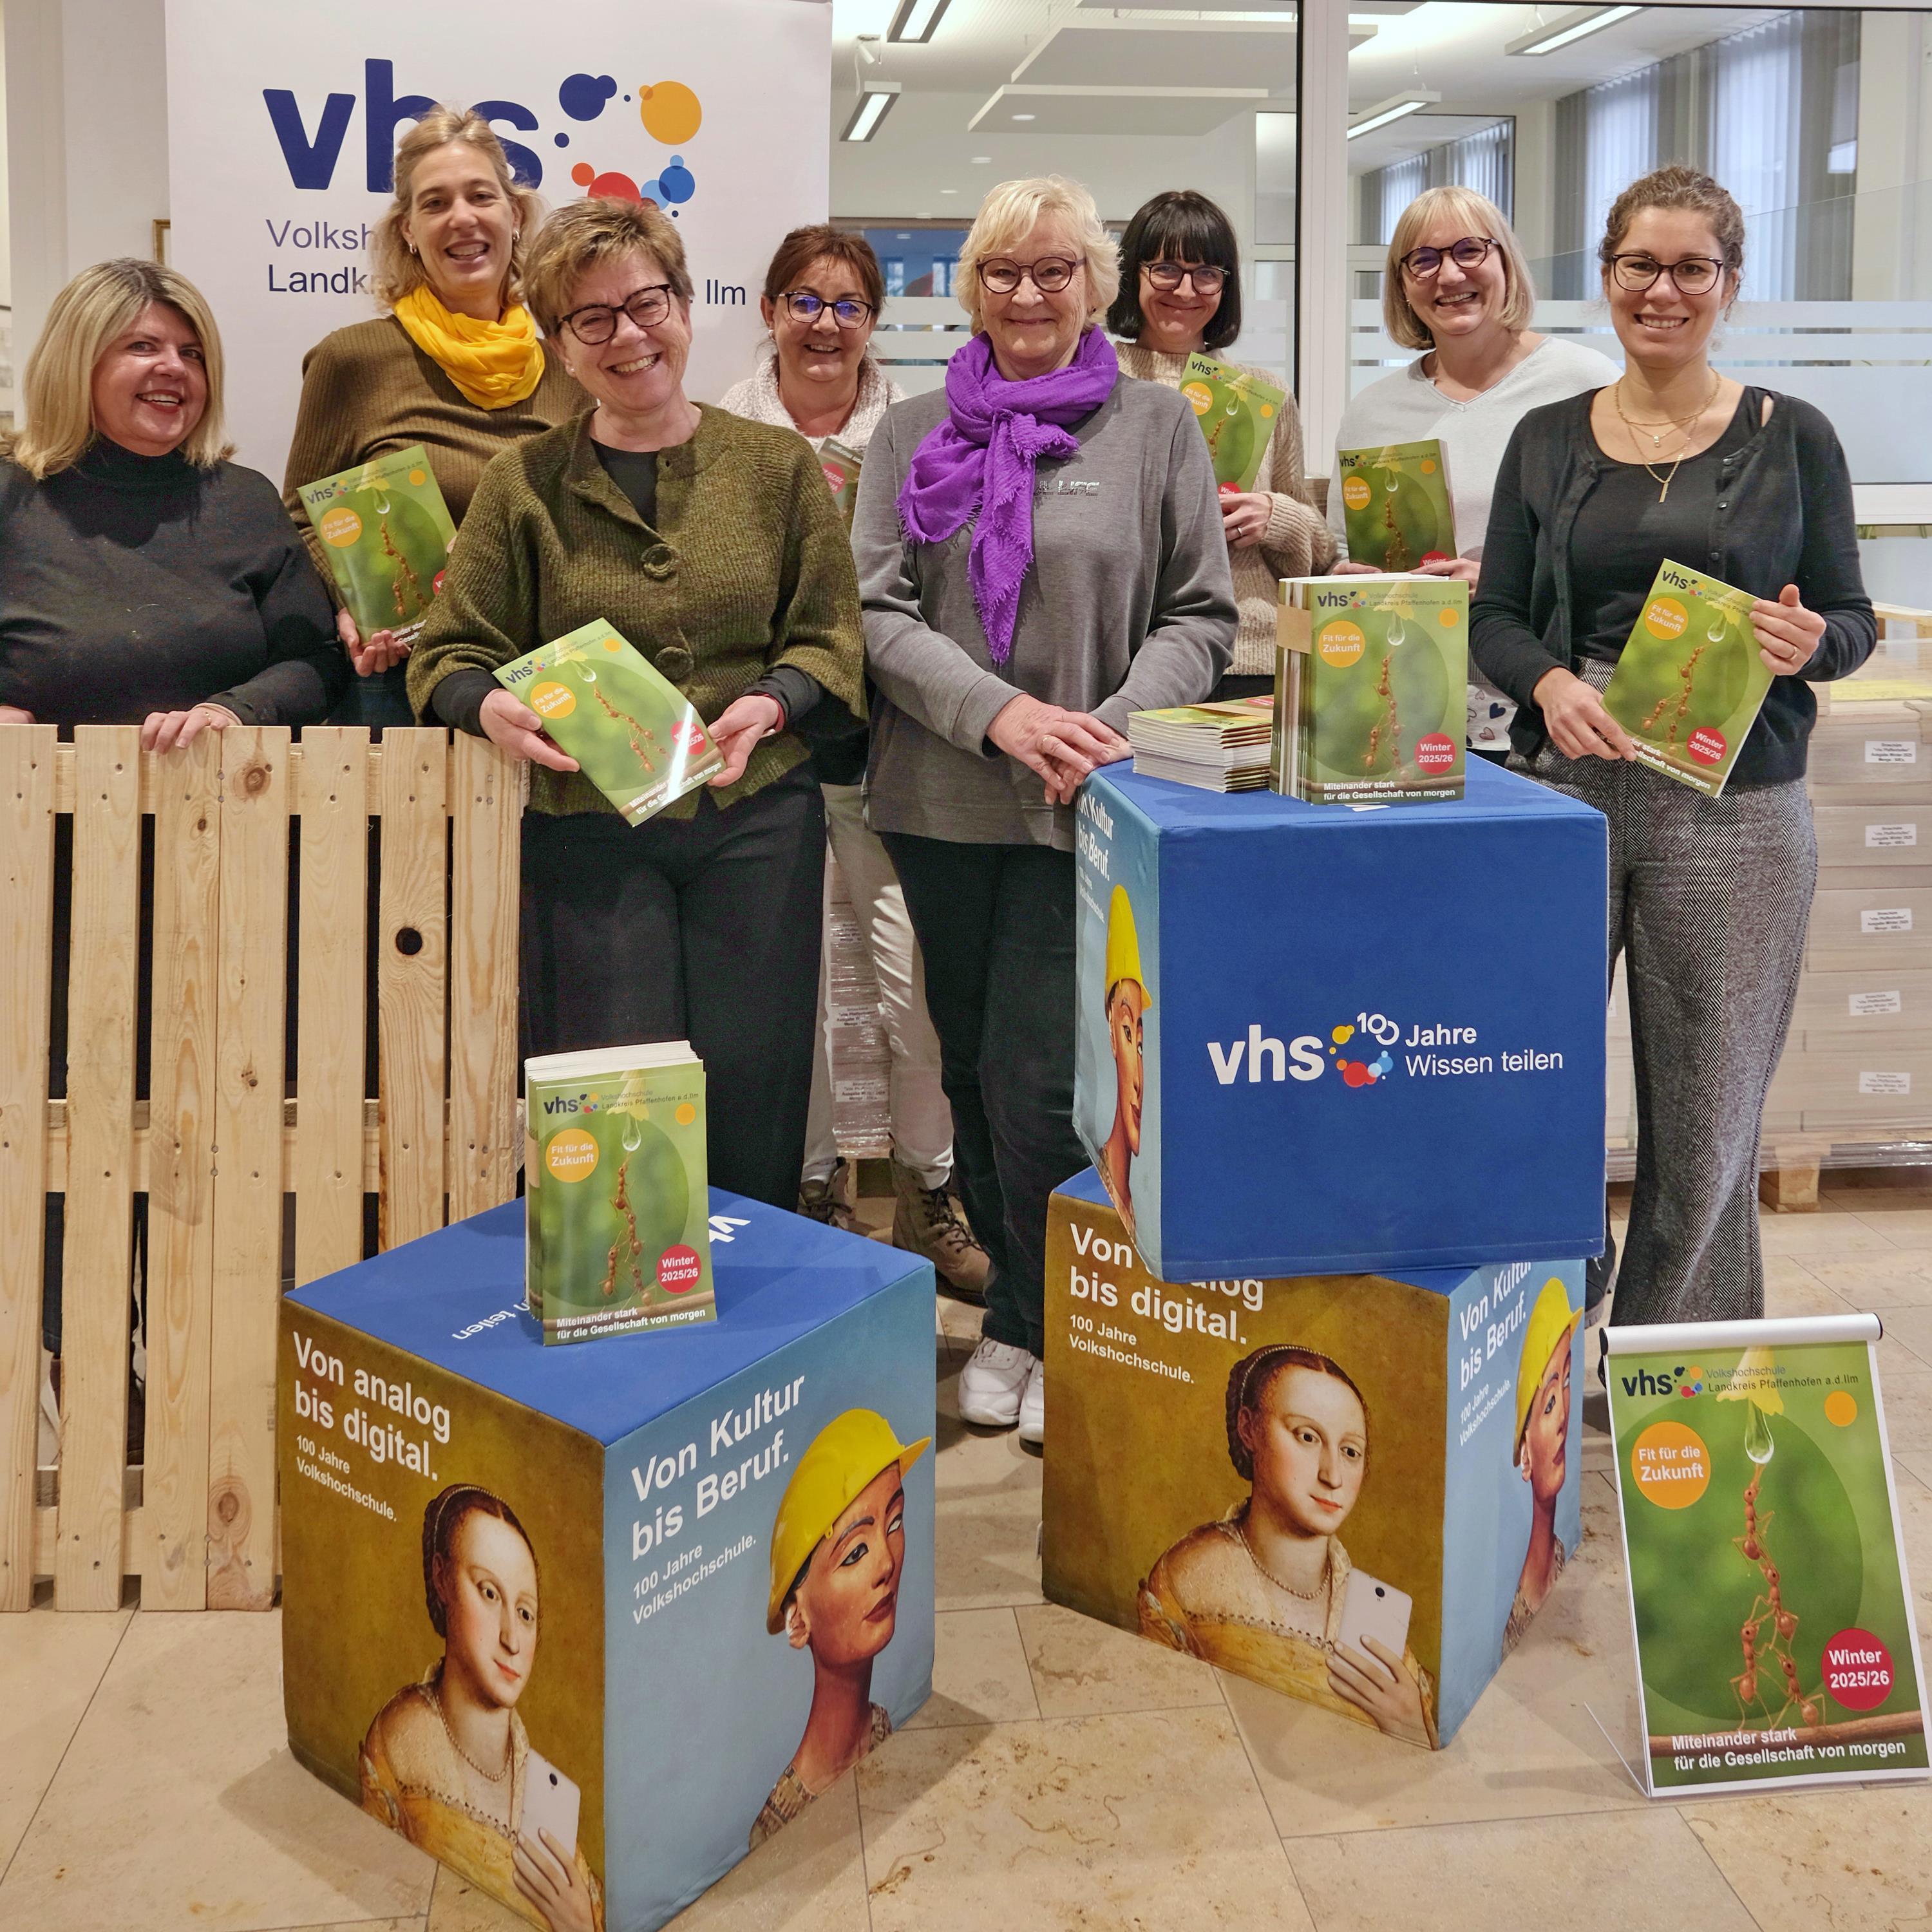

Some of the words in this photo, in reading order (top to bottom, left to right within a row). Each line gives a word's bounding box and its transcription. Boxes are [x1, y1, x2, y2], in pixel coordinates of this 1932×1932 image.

[706, 279, 746, 305] Ilm
[1191, 361, 1212, 375] vhs
[1340, 456, 1356, 467] vhs
[306, 488, 334, 504] vhs
[1662, 571, 1689, 590] vhs
[1318, 591, 1348, 607] vhs
[1647, 612, 1682, 632] Zukunft
[1652, 604, 1662, 612] Fit
[1662, 608, 1673, 617] für
[1673, 614, 1685, 623] die
[1323, 643, 1361, 653] Zukunft
[506, 665, 533, 683] vhs
[554, 687, 565, 696] die
[540, 692, 572, 714] Zukunft
[1420, 743, 1452, 752] Winter
[1642, 743, 1661, 757] stark
[1689, 741, 1721, 761] 2025/26
[1695, 732, 1724, 750] Winter
[1419, 754, 1453, 763] 2025/26
[1323, 782, 1372, 791] Miteinander
[1374, 780, 1395, 789] stark
[1666, 765, 1680, 775] von
[1681, 772, 1711, 790] morgen
[629, 781, 667, 808] Miteinander
[1352, 790, 1404, 799] Gesellschaft
[1423, 789, 1455, 799] morgen
[636, 805, 648, 815] für
[647, 799, 659, 808] die
[1088, 794, 1113, 840] Kultur
[1078, 820, 1088, 855] bis
[1088, 832, 1110, 882] Beruf.
[1405, 1023, 1477, 1048] Jahre
[1207, 1024, 1325, 1085] vhs
[1405, 1053, 1493, 1077] Wissen
[1501, 1049, 1564, 1072] teilen
[544, 1096, 578, 1114] vhs
[602, 1100, 633, 1110] Landkreis
[635, 1095, 676, 1105] Pfaffenhofen
[551, 1146, 563, 1154] Fit
[565, 1144, 578, 1152] für
[580, 1142, 594, 1151] die
[551, 1153, 594, 1167] Zukunft
[1070, 1222, 1133, 1269] Von
[662, 1256, 696, 1268] Winter
[661, 1267, 698, 1282] 2025/26
[1070, 1265, 1119, 1308] bis
[1130, 1285, 1247, 1345] digital.
[451, 1310, 516, 1340] teilen
[556, 1311, 613, 1328] Miteinander
[614, 1307, 638, 1318] stark
[557, 1330, 571, 1340] für
[573, 1328, 588, 1338] die
[590, 1318, 649, 1334] Gesellschaft
[650, 1315, 668, 1325] von
[670, 1309, 706, 1323] morgen
[1460, 1293, 1488, 1341] Von
[1070, 1314, 1093, 1333] 100
[1097, 1323, 1137, 1346] Jahre
[1461, 1347, 1482, 1392] bis
[1486, 1290, 1526, 1361] Beruf.
[1068, 1333, 1195, 1384] Volkshochschule.
[1622, 1368, 1673, 1397] vhs
[1706, 1365, 1786, 1379] Volkshochschule
[293, 1331, 344, 1386] Von
[354, 1368, 450, 1444] analog
[1709, 1379, 1757, 1393] Landkreis
[1760, 1376, 1823, 1390] Pfaffenhofen
[1459, 1379, 1511, 1446] Volkshochschule.
[1461, 1406, 1472, 1425] 100
[1472, 1383, 1490, 1411] Jahre
[296, 1379, 334, 1429] bis
[343, 1407, 438, 1481] digital.
[631, 1441, 697, 1502] Von
[710, 1375, 805, 1458] Kultur
[296, 1434, 316, 1457] 100
[318, 1446, 350, 1474] Jahre
[1638, 1447, 1656, 1461] Fit
[1658, 1446, 1678, 1460] für
[1681, 1444, 1701, 1458] die
[1640, 1463, 1704, 1482] Zukunft
[296, 1456, 397, 1522] Volkshochschule.
[632, 1504, 683, 1562] bis
[697, 1428, 789, 1519] Beruf.
[632, 1533, 757, 1625] Volkshochschule.
[633, 1570, 658, 1600] 100
[663, 1544, 703, 1583] Jahre
[1829, 1649, 1882, 1665] Winter
[1830, 1670, 1889, 1689] 2025/26
[1672, 1730, 1757, 1751] Miteinander
[1760, 1726, 1797, 1743] stark
[1674, 1756, 1695, 1771] für
[1698, 1752, 1721, 1768] die
[1725, 1745, 1815, 1766] Gesellschaft
[1817, 1743, 1846, 1759] von
[1849, 1740, 1906, 1759] morgen
